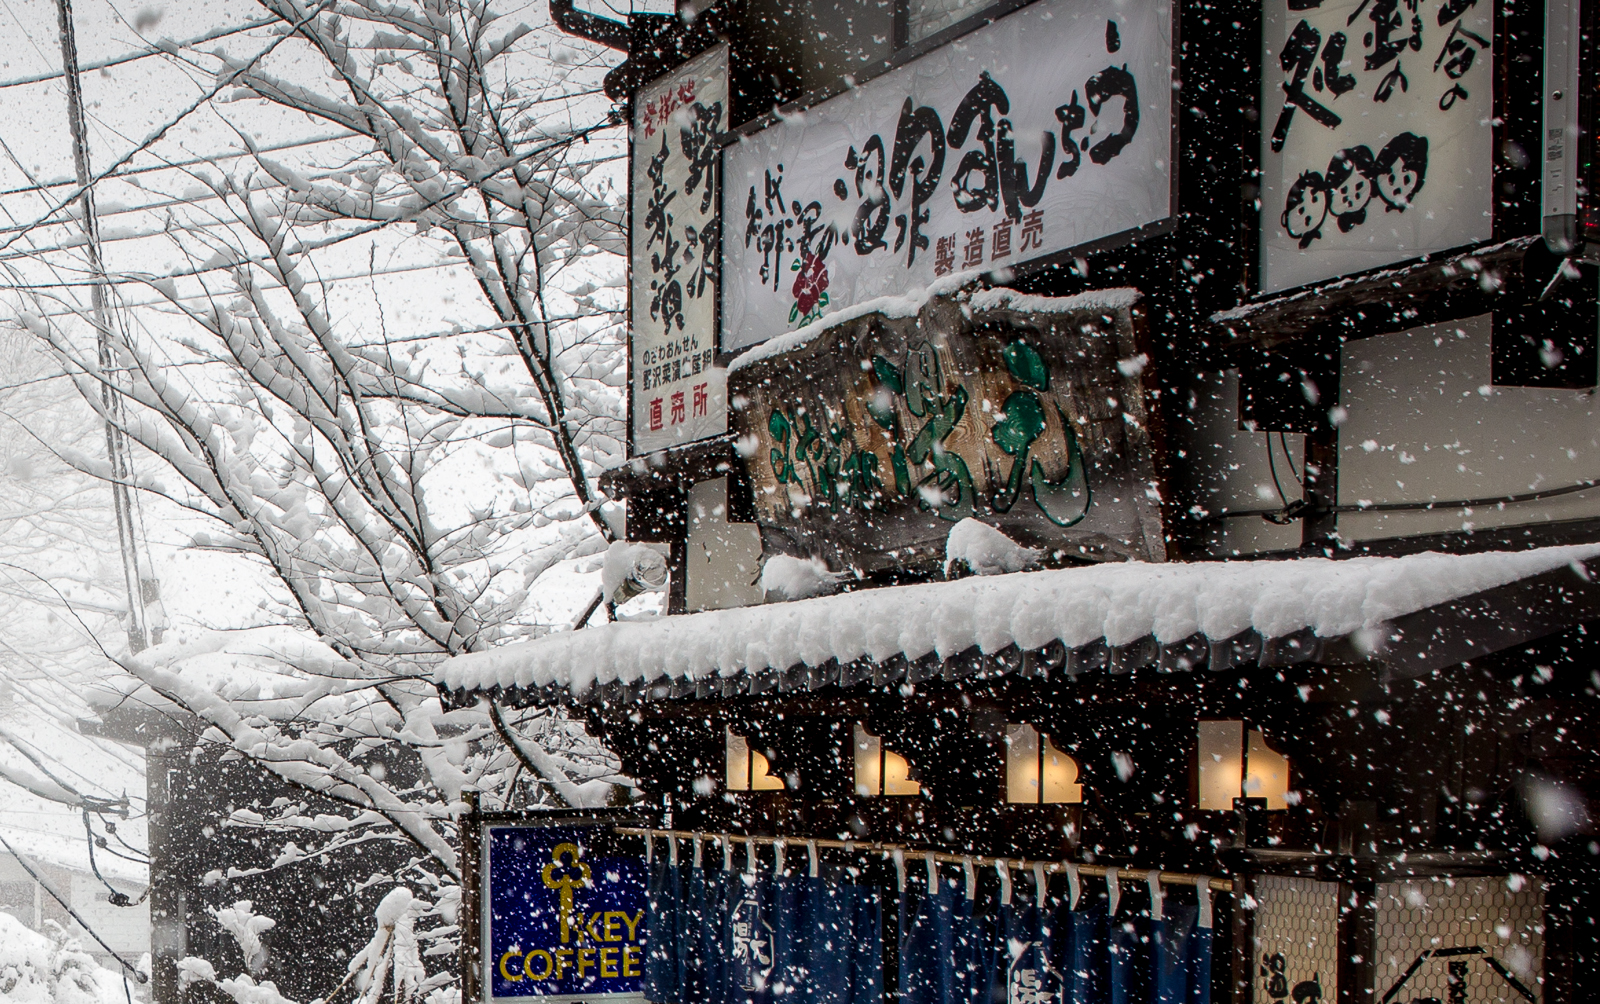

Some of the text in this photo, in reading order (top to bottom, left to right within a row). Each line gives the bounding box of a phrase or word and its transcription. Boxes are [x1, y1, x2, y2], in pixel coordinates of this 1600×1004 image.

[934, 209, 1045, 277] 製造直売
[643, 333, 699, 366] のざわおんせん
[649, 382, 708, 431] 直売所
[573, 911, 645, 943] KEY
[500, 946, 642, 982] COFFEE
